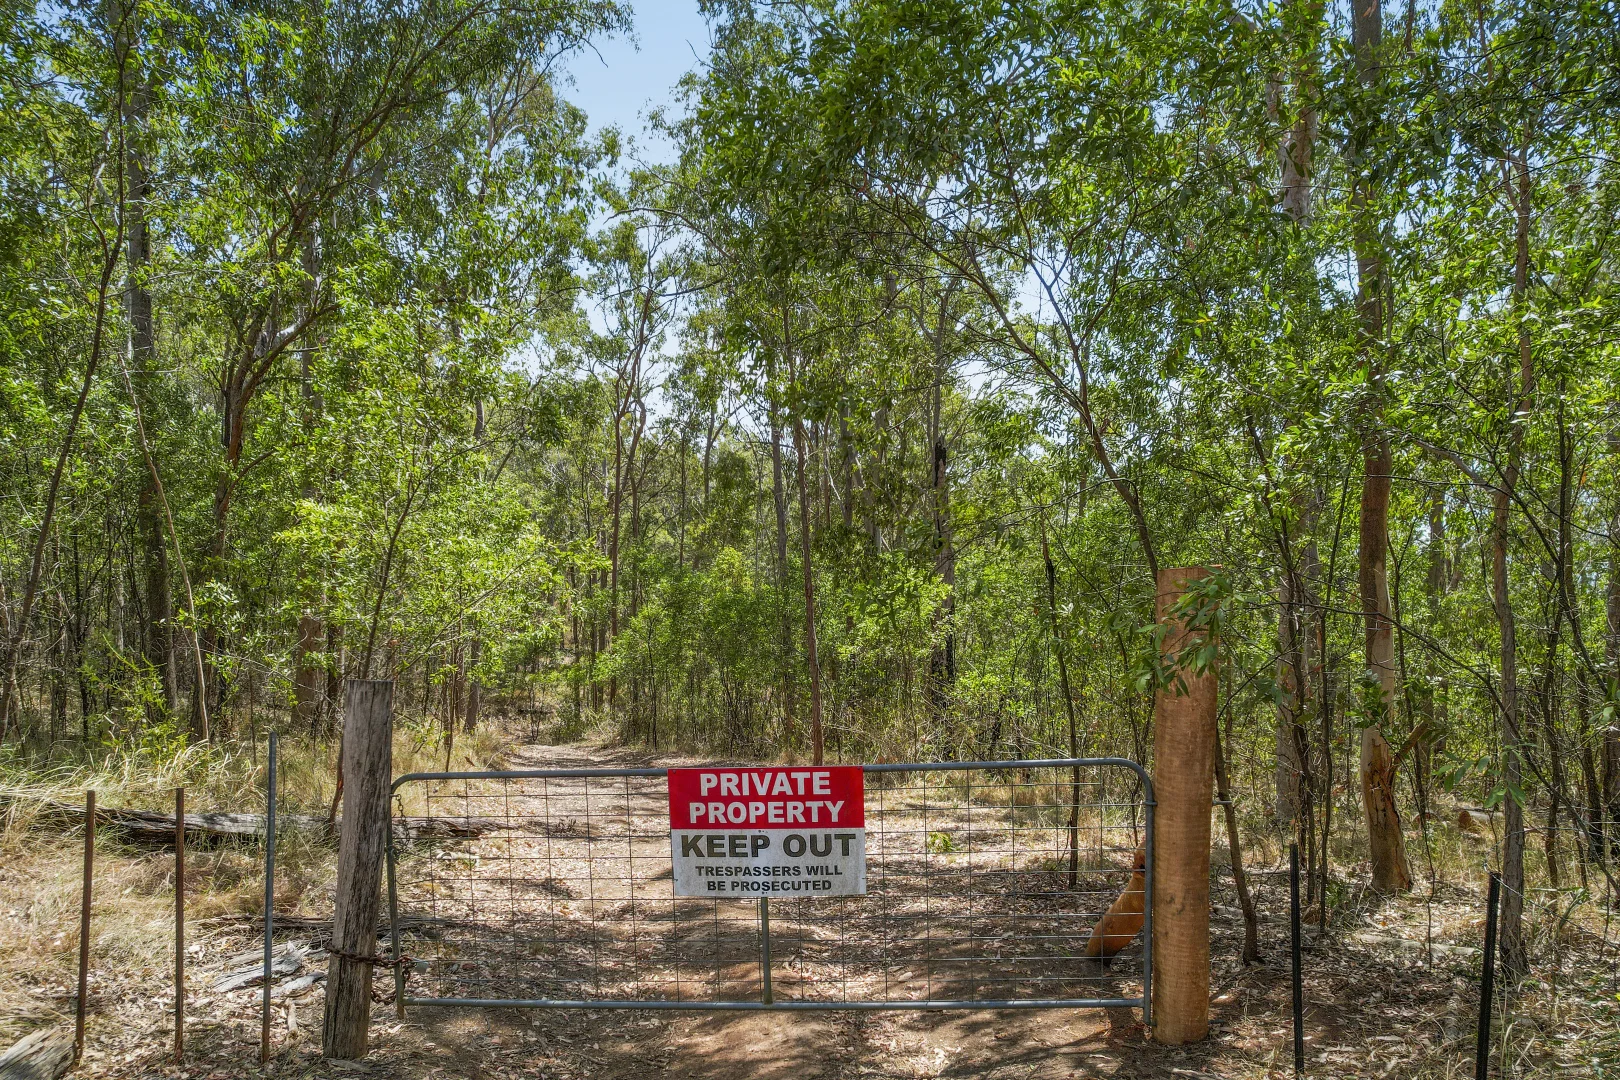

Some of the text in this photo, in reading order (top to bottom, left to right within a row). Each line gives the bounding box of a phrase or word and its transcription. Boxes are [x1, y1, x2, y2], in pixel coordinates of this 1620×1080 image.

[700, 771, 831, 797] PRIVATE
[689, 800, 845, 824] PROPERTY
[680, 833, 856, 858] KEEP OUT
[695, 865, 843, 877] TRESPASSERS WILL
[707, 880, 832, 892] BE PROSECUTED
